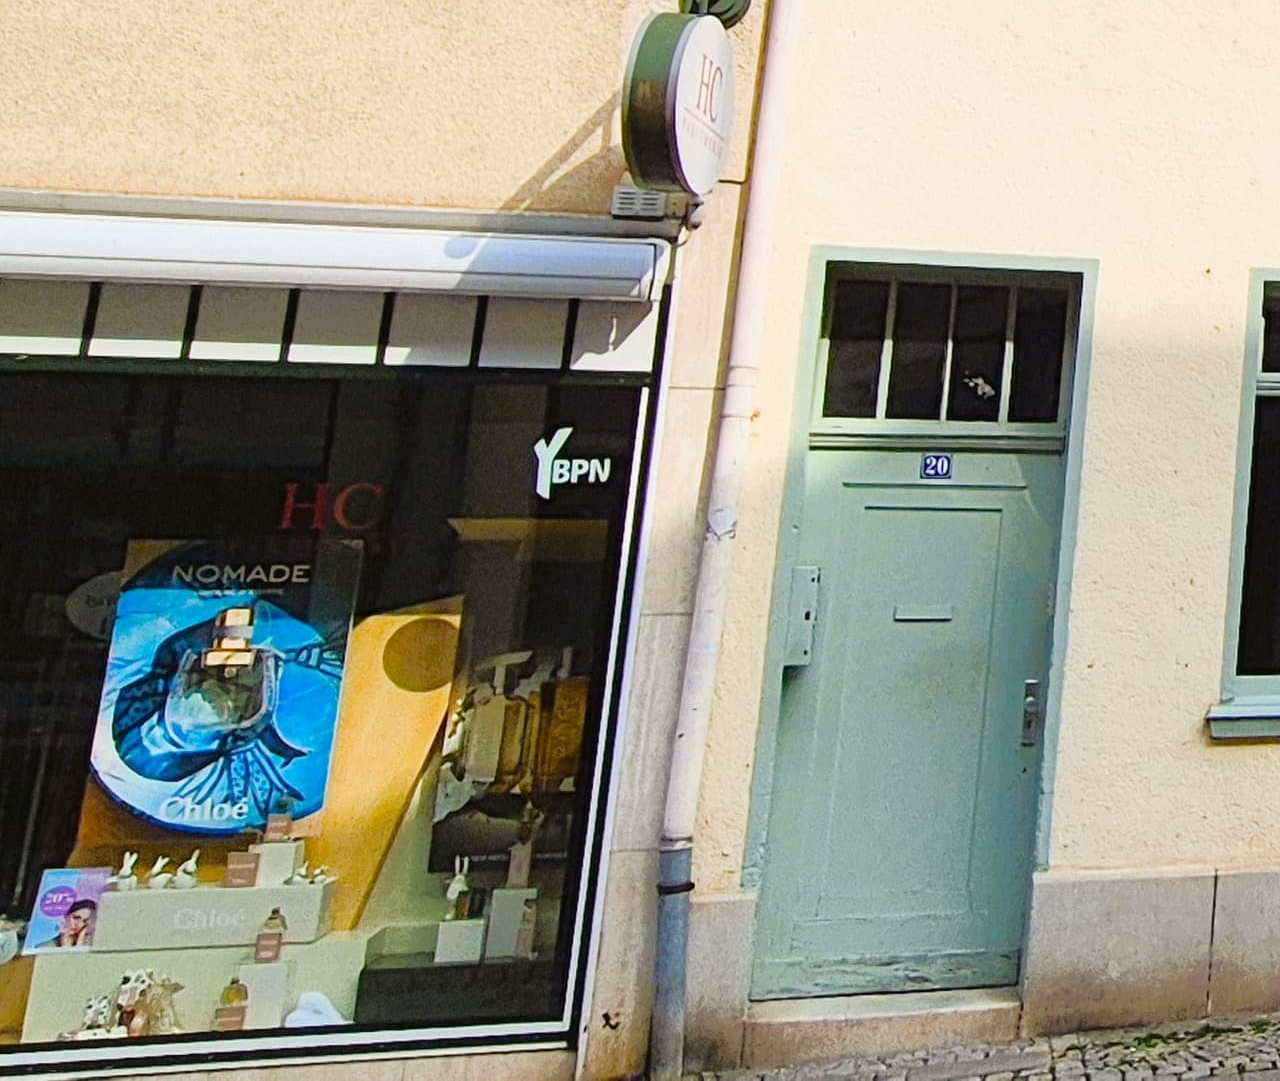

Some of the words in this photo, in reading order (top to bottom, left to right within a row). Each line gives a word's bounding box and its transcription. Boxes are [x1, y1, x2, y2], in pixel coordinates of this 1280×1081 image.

[696, 53, 724, 123] HC
[925, 457, 949, 475] 20
[279, 482, 384, 530] HC
[171, 565, 311, 584] NOMADE
[159, 796, 249, 820] Chloé
